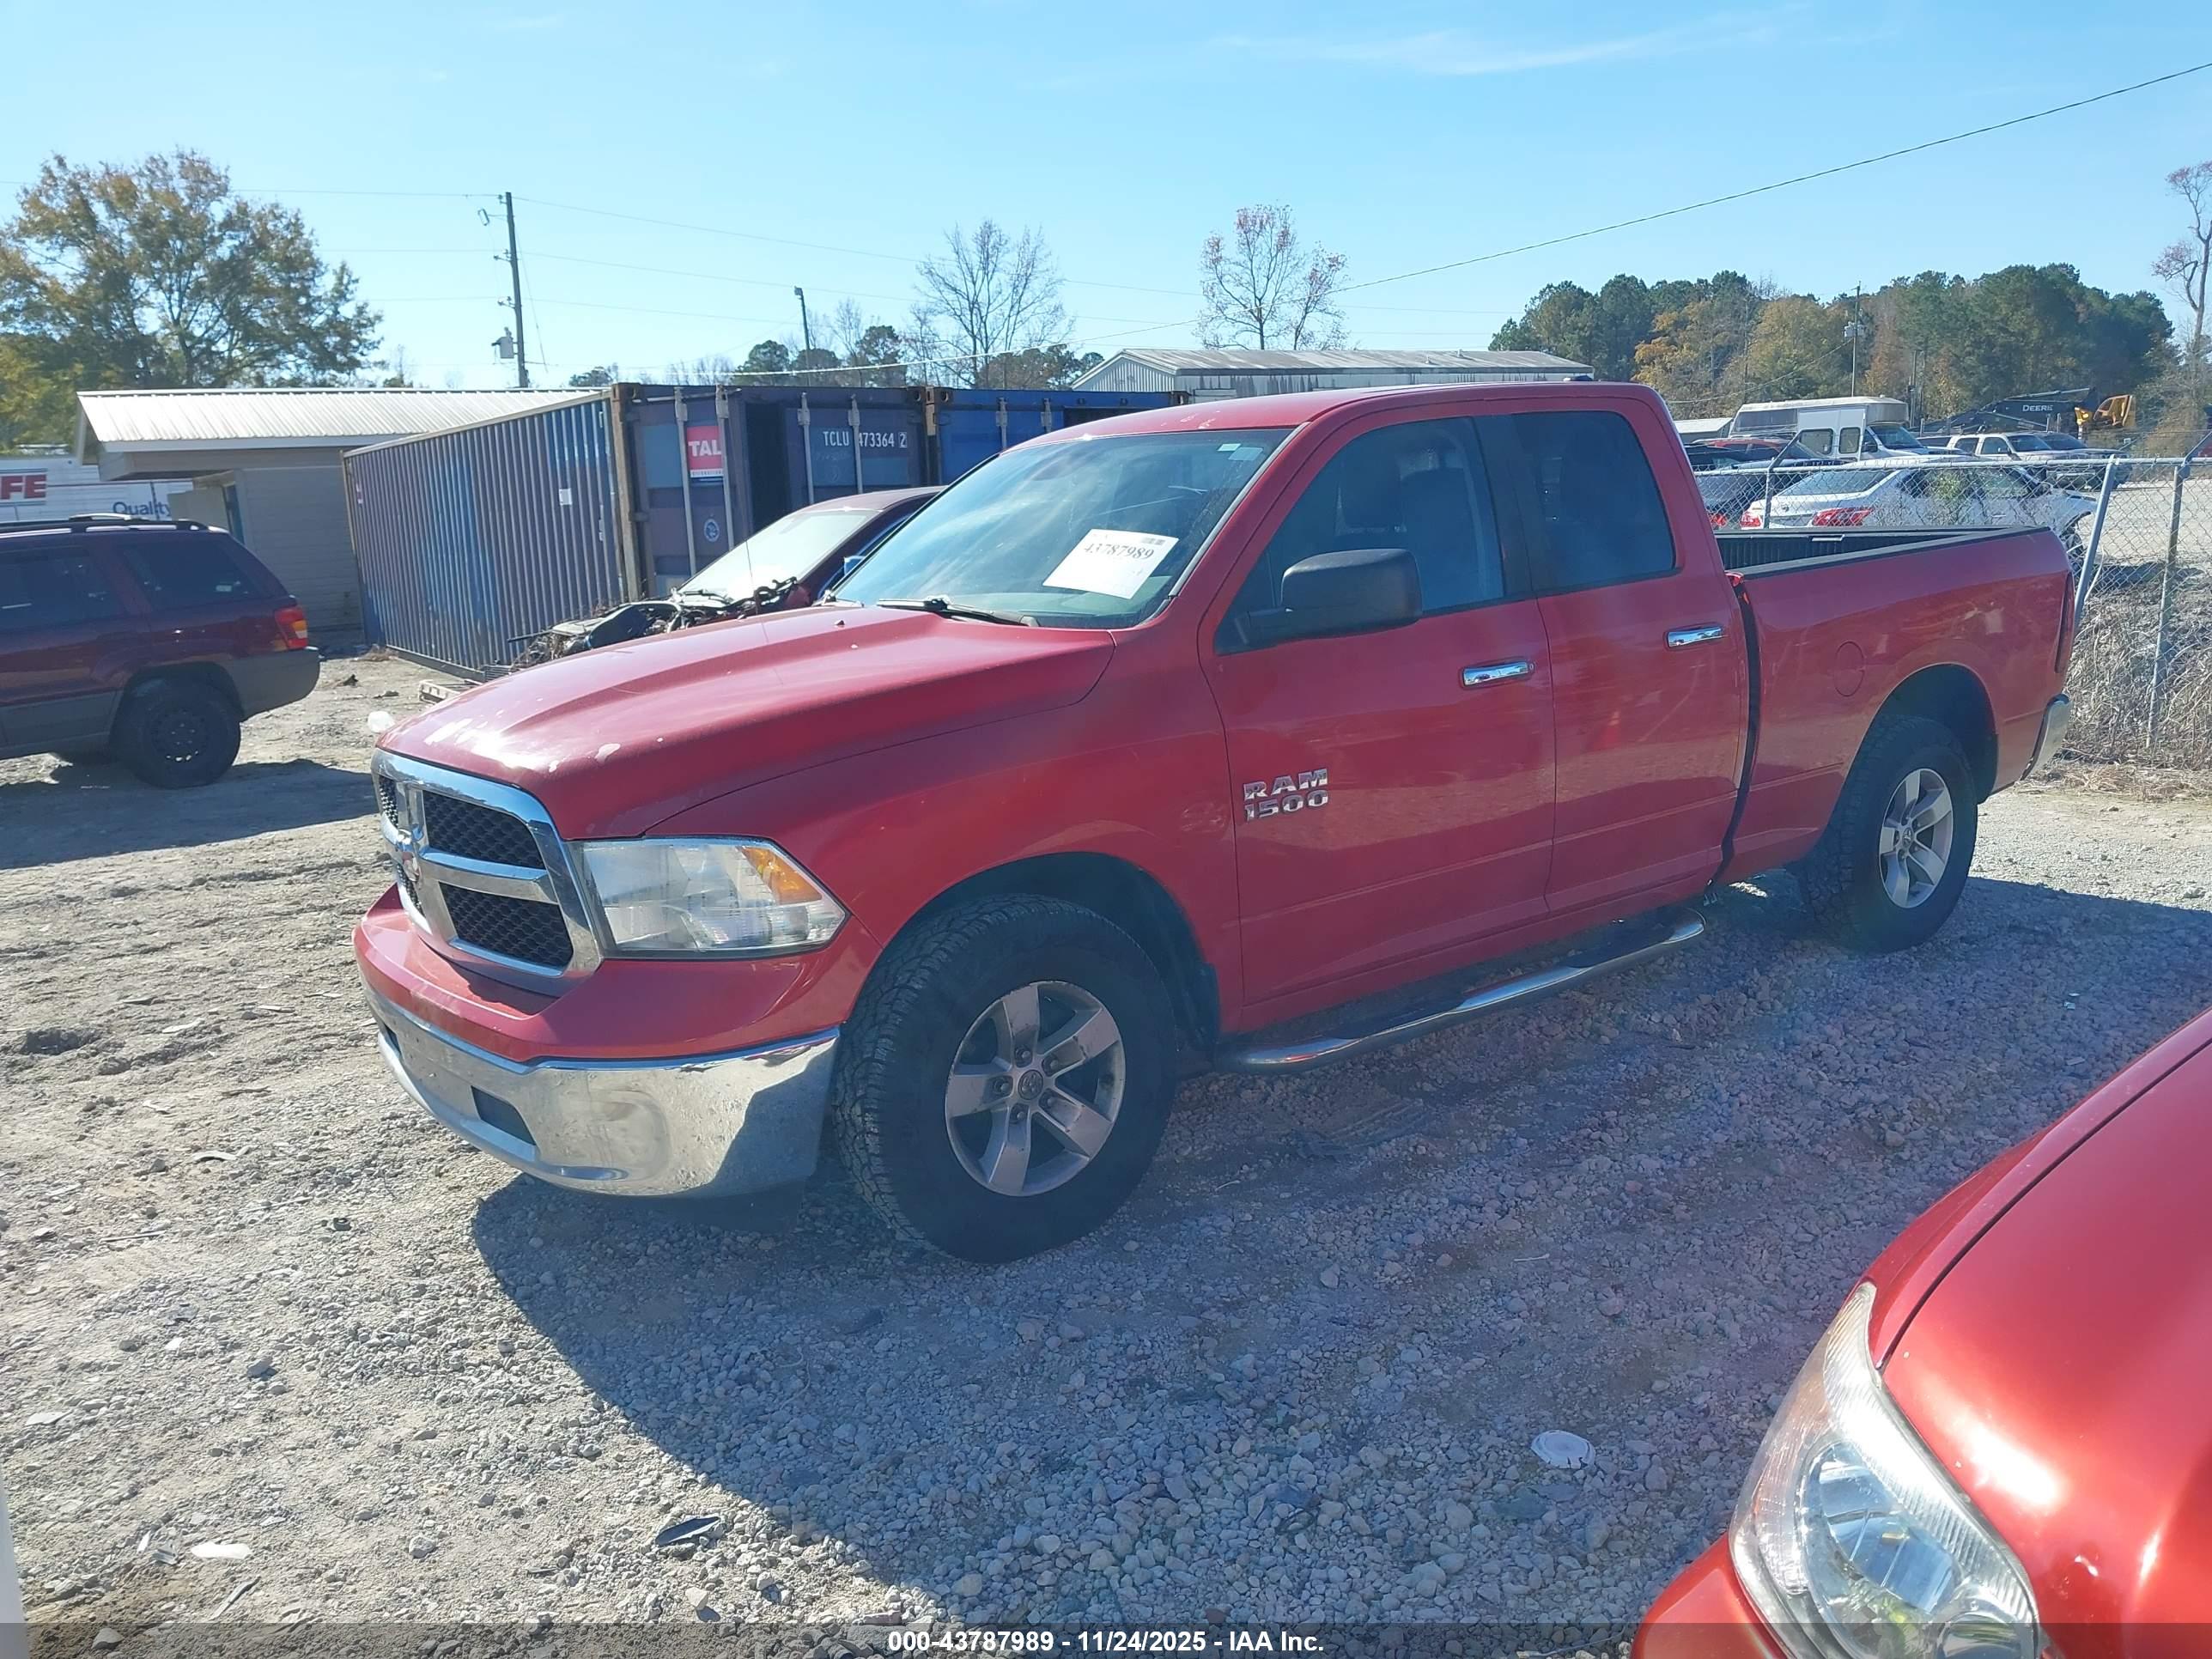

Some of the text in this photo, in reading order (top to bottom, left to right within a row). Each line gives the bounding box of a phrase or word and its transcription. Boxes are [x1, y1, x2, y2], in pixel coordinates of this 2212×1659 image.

[688, 439, 722, 458] TAL
[822, 431, 907, 448] TCLU 473364 2
[1083, 542, 1155, 562] 43787989
[1243, 768, 1329, 800] RAM
[1243, 789, 1329, 823] 1500
